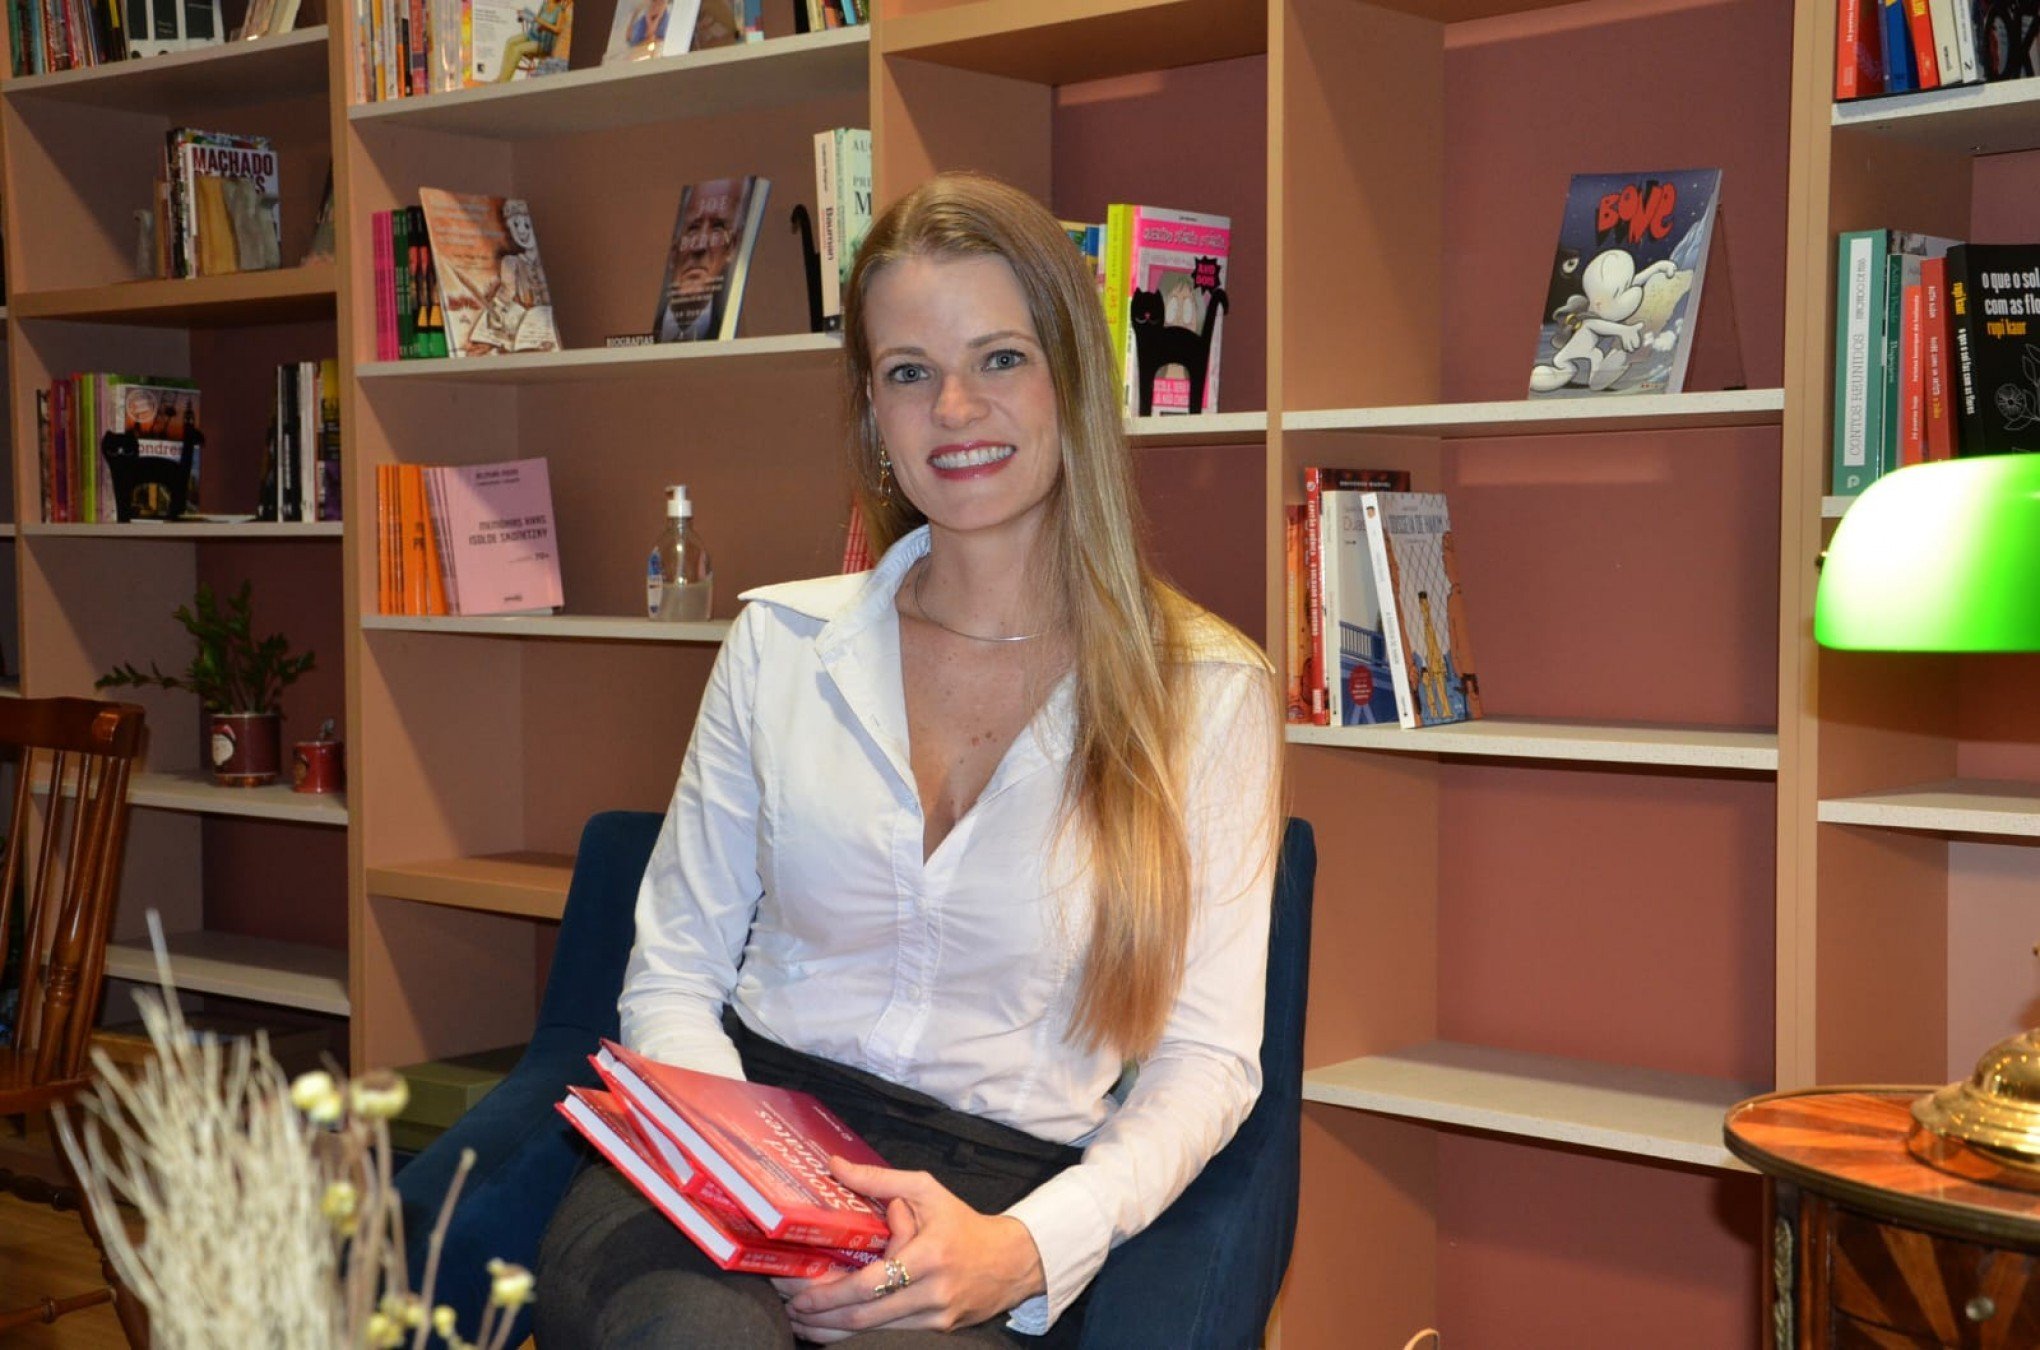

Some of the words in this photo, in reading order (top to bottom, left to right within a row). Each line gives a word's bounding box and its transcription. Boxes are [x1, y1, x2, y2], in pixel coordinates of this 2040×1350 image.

[192, 147, 274, 177] MACHADO
[1597, 181, 1677, 243] BONE
[1982, 272, 1989, 289] o
[1990, 272, 2011, 293] que
[2012, 272, 2021, 289] o
[2022, 267, 2040, 289] sol
[1985, 298, 2009, 316] com
[2009, 298, 2024, 316] as
[1987, 319, 2005, 340] rupi
[2005, 318, 2026, 335] kaur
[763, 1139, 841, 1210] Storied
